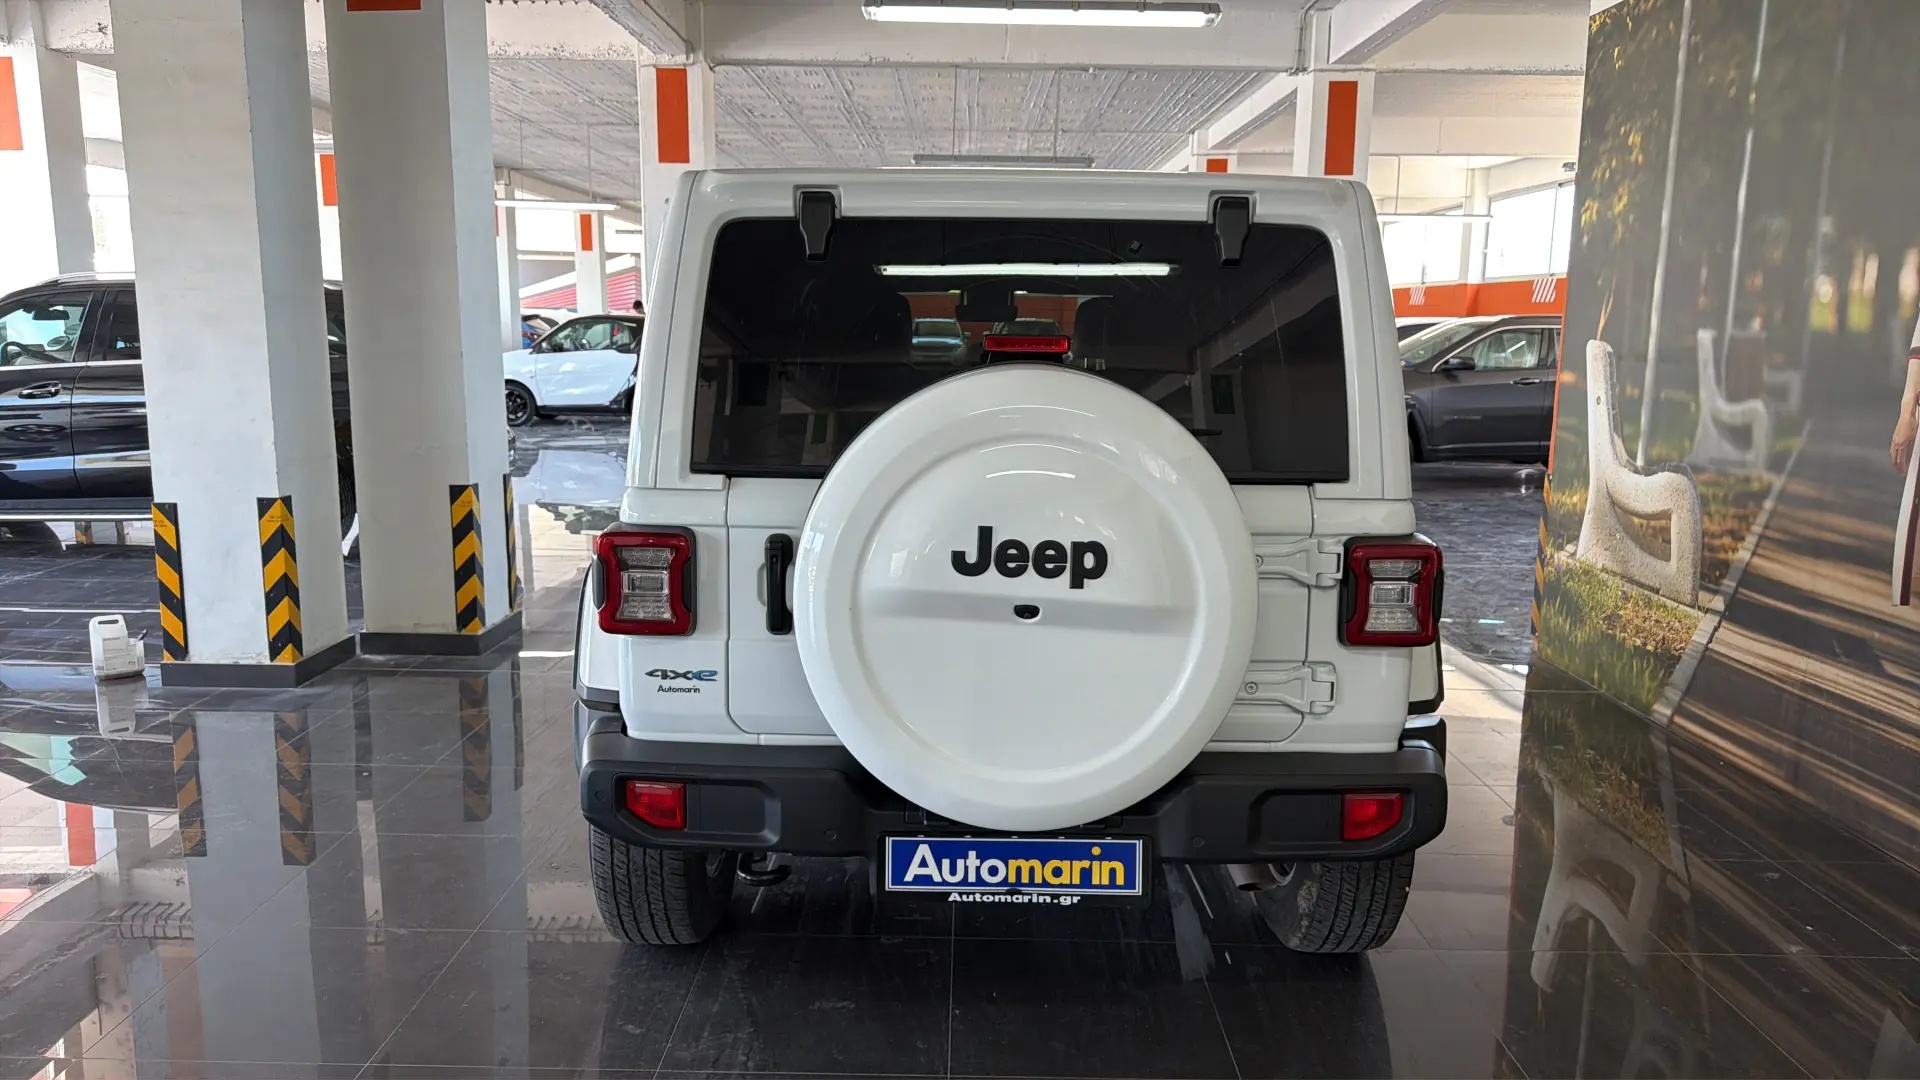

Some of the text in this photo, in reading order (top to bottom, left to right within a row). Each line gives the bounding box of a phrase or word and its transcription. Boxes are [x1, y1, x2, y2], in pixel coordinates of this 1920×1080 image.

[951, 526, 1108, 589] Jeep
[657, 684, 701, 693] Automarin
[903, 843, 1125, 885] Automarin
[948, 892, 1080, 905] Automarin.gr
